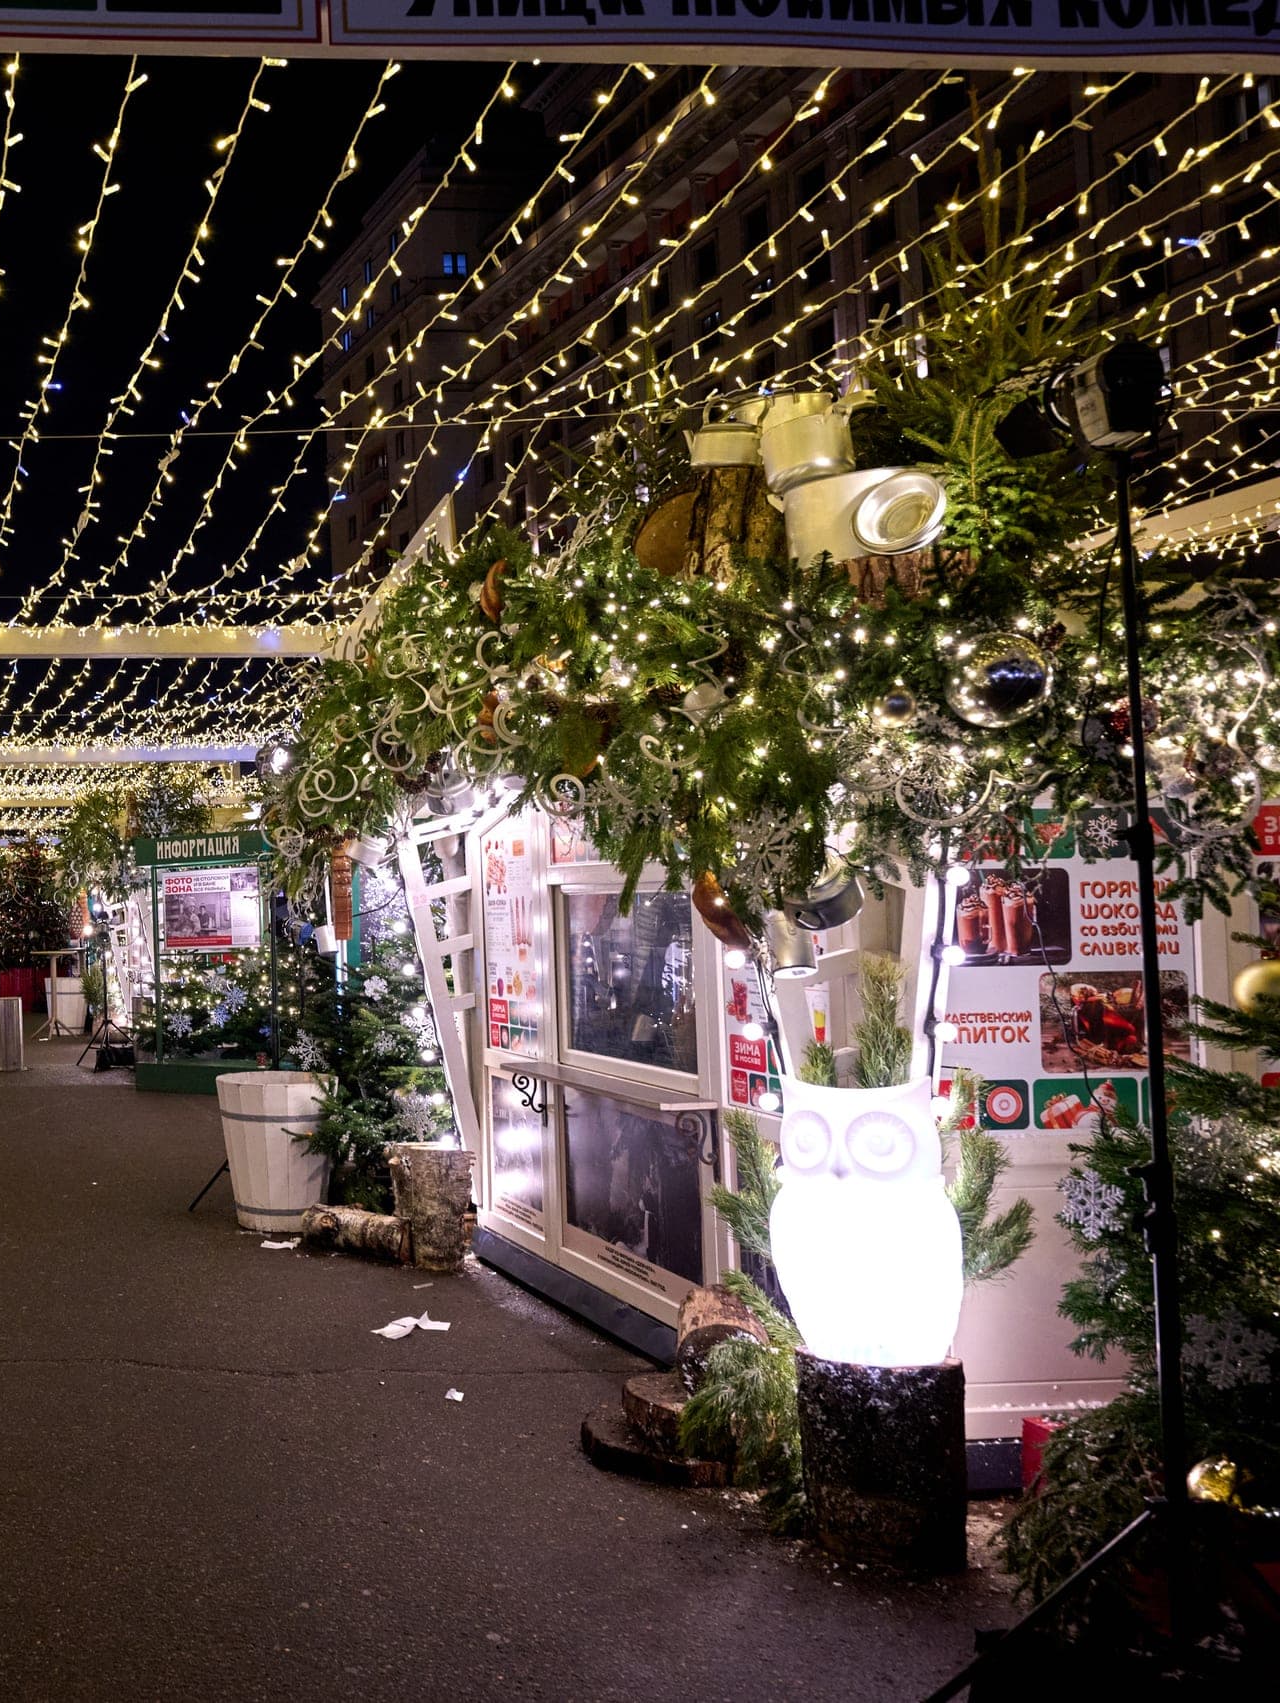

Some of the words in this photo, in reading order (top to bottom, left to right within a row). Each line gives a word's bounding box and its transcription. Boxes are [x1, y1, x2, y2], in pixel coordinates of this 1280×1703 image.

[156, 835, 240, 860] ИНФОРМАЦИЯ
[165, 877, 193, 886] ФОТО
[165, 885, 193, 894] ЗОНА
[1080, 902, 1178, 921] ШОКОАД
[1080, 925, 1098, 937] со
[1101, 922, 1179, 937] взбими
[1079, 941, 1180, 956] СЛИВКМИ
[943, 1025, 1031, 1044] ПИТОК
[734, 1041, 761, 1057] ЗИМА
[740, 1055, 761, 1065] МОСКВЕ
